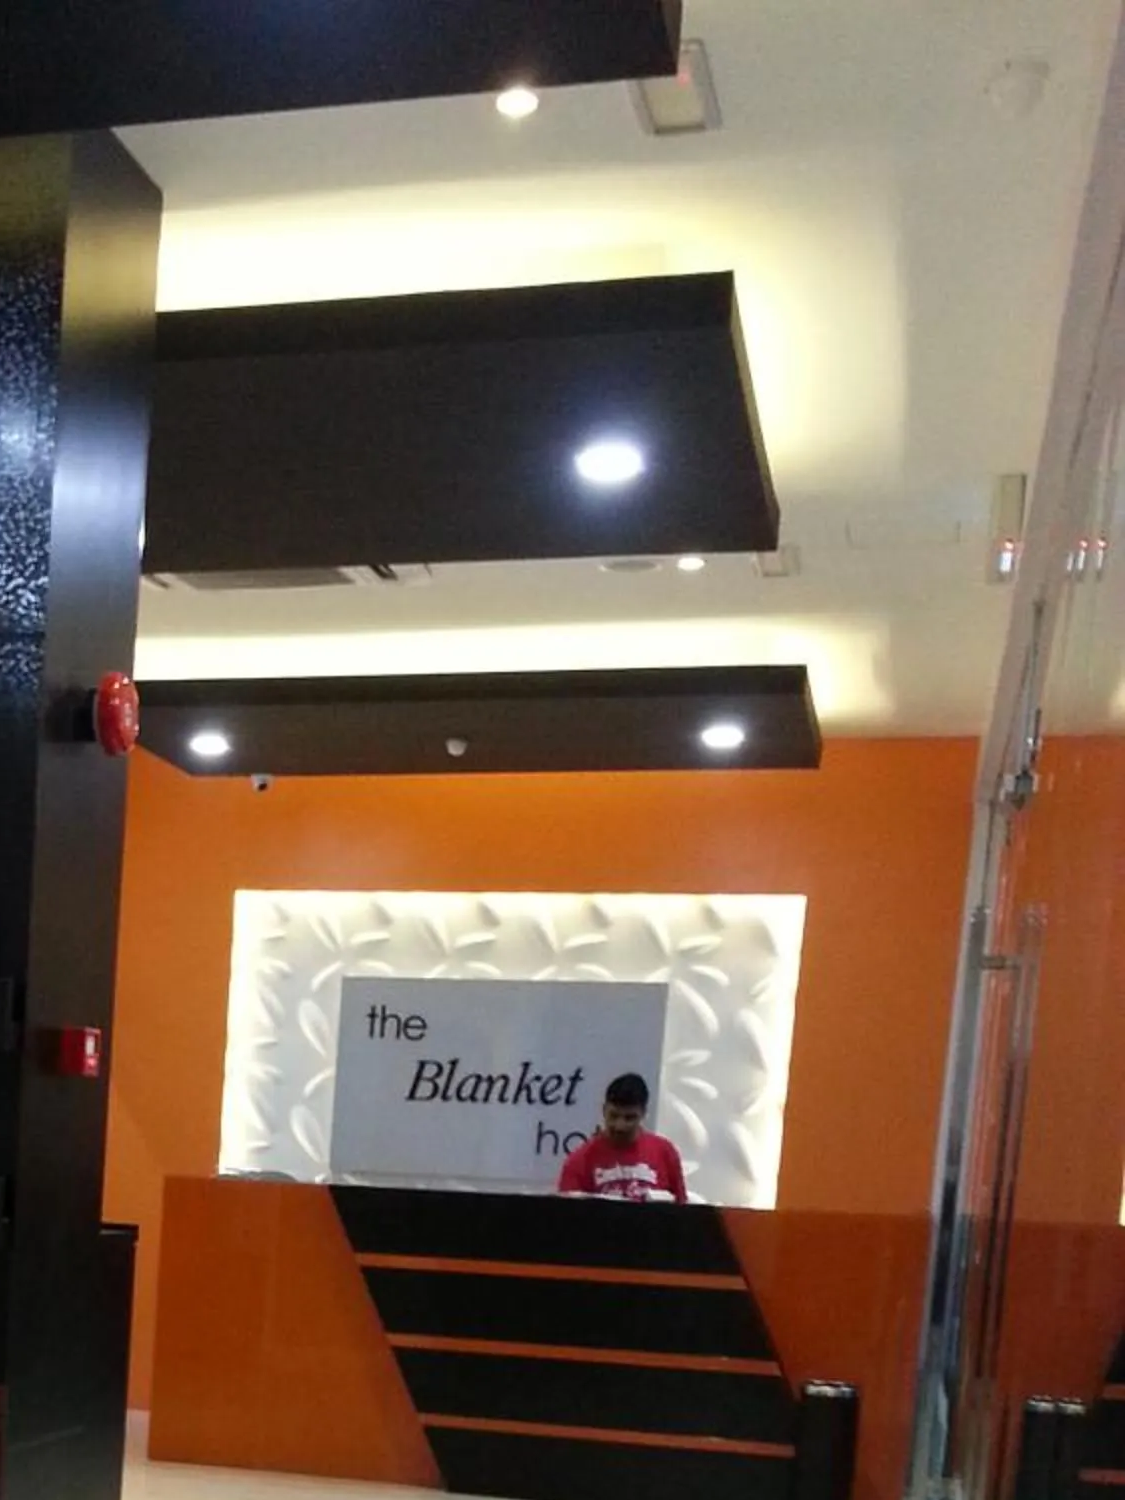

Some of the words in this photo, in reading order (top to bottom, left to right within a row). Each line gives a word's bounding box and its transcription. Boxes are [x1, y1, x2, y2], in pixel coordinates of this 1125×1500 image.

[366, 1005, 428, 1041] the
[406, 1058, 585, 1106] Blanket
[536, 1121, 602, 1155] ho
